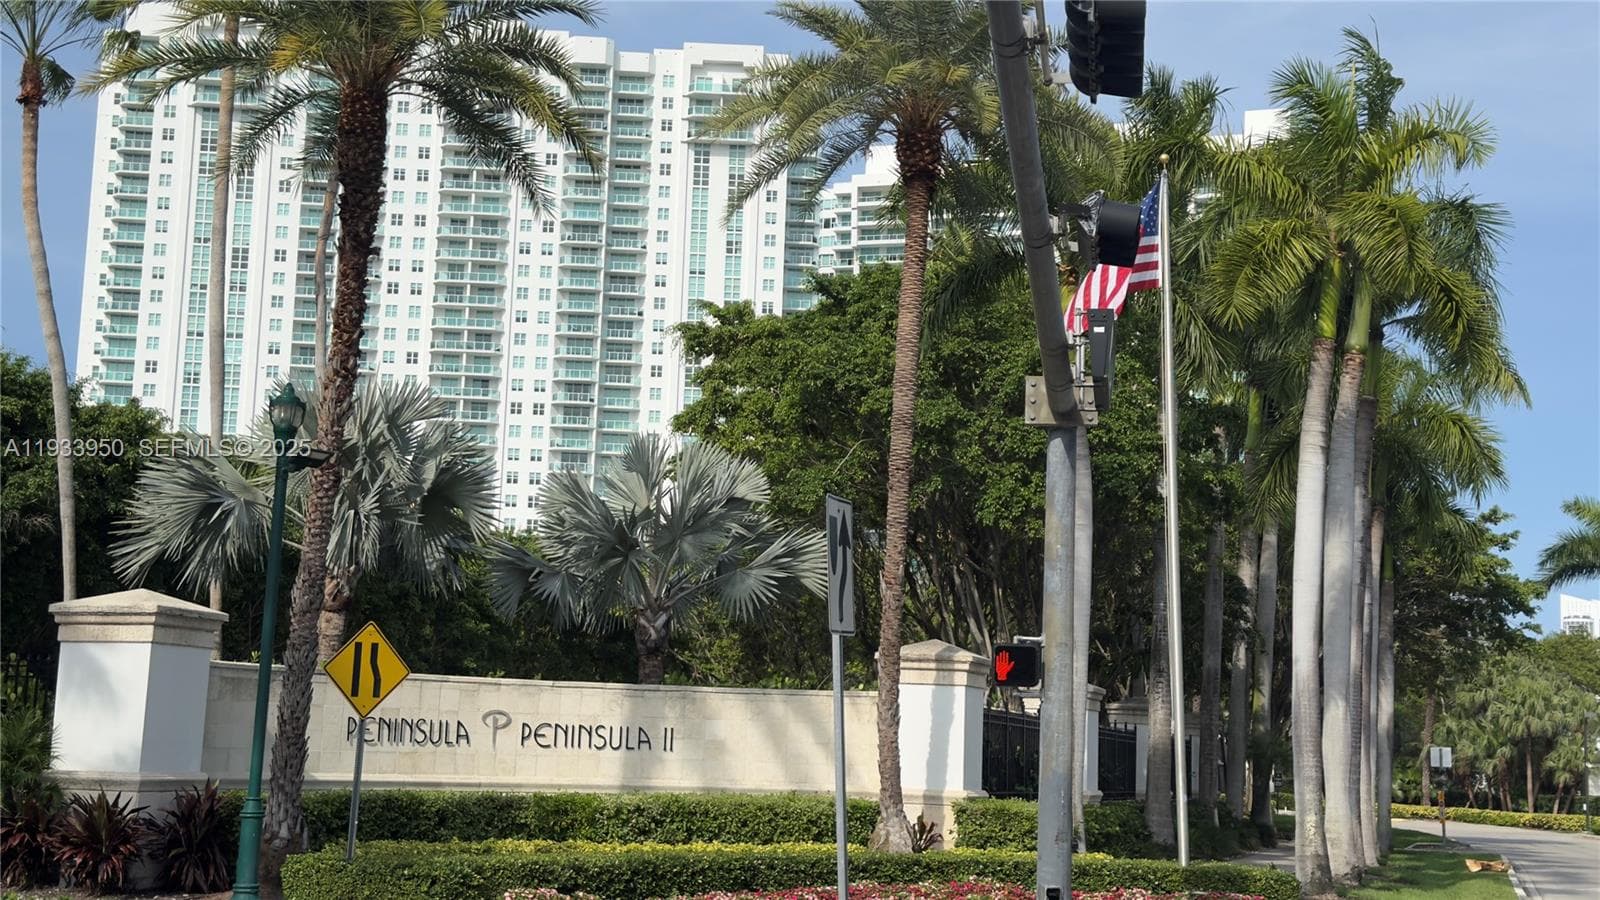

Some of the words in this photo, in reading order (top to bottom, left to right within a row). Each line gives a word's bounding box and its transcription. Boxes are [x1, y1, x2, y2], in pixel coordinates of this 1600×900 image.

[347, 716, 470, 745] PENINSULA
[520, 722, 652, 751] PENINSULA
[662, 727, 675, 752] II
